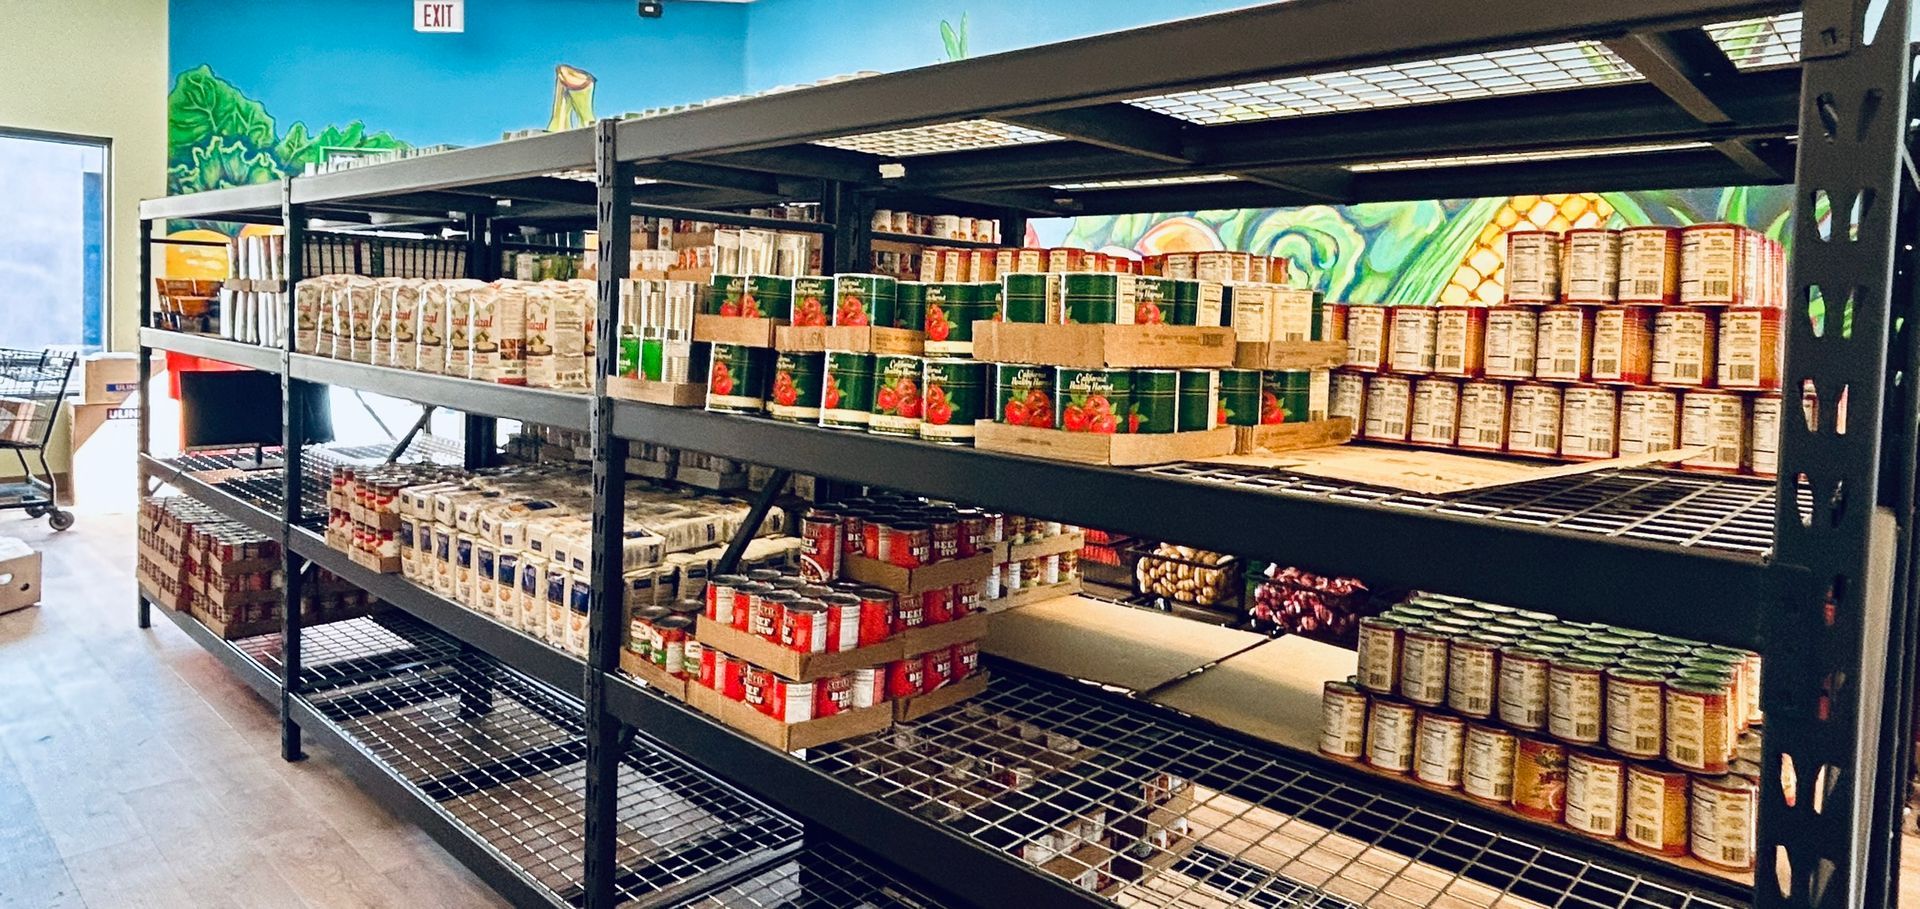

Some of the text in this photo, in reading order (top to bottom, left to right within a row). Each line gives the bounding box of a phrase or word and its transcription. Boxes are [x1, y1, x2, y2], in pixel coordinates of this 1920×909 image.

[424, 4, 453, 27] EXIT
[1076, 372, 1107, 384] California
[1069, 380, 1114, 392] Healthy Harvest
[109, 409, 138, 419] ULIN
